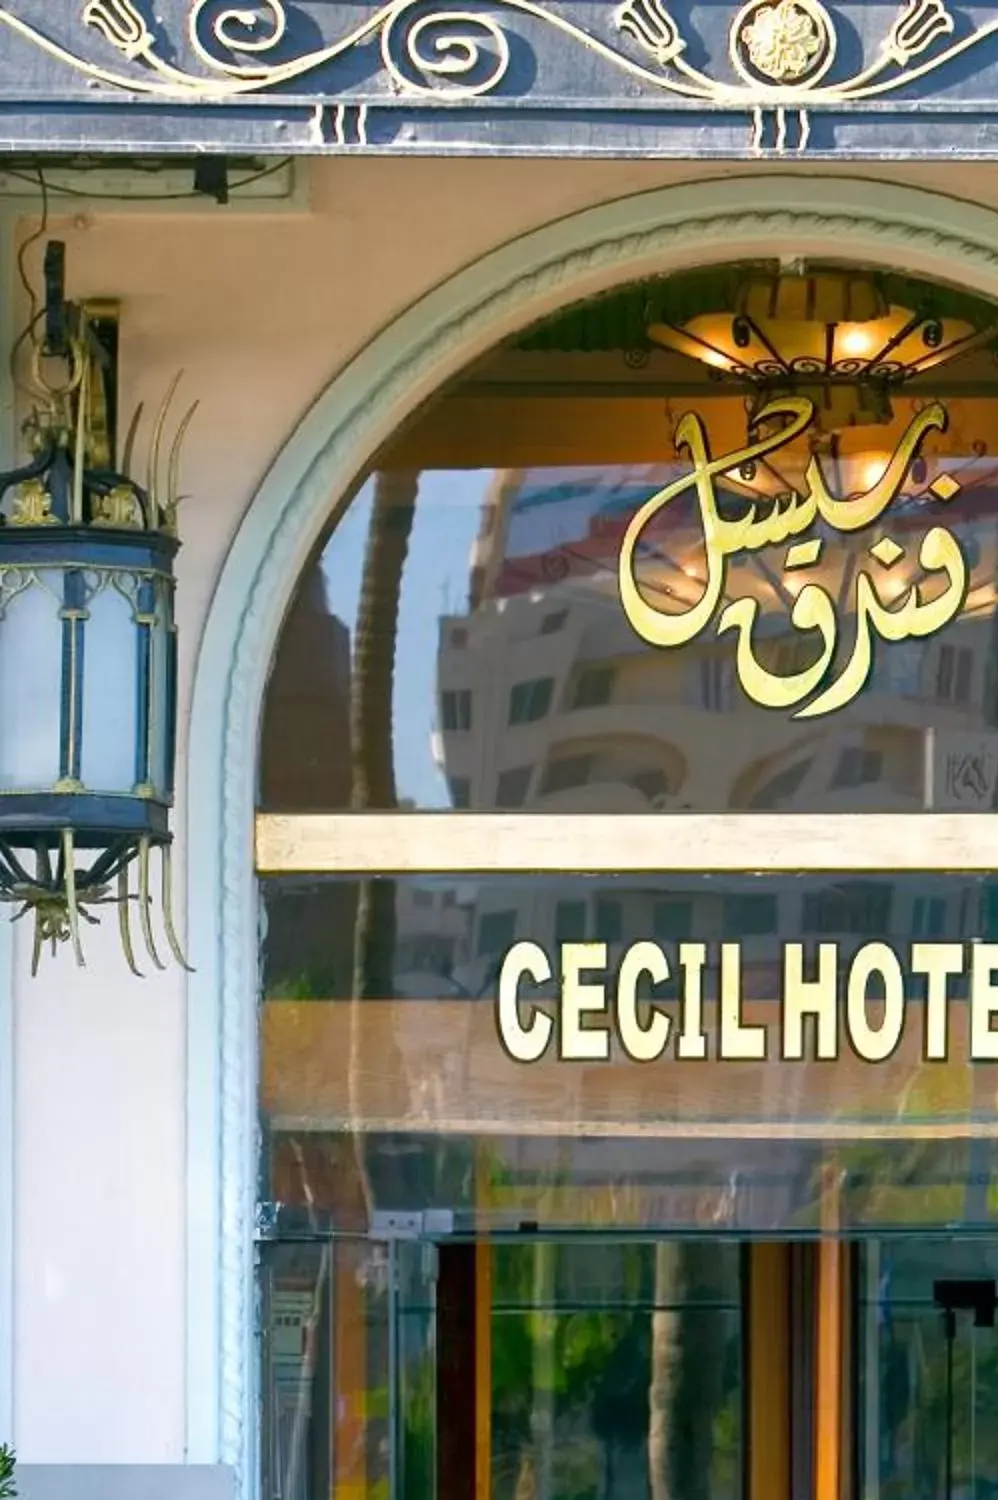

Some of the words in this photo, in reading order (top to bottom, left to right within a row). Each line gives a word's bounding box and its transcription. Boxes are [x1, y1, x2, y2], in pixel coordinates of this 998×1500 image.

[618, 396, 948, 649] سيسل
[716, 473, 971, 720] فندق
[497, 939, 767, 1062] CECIL
